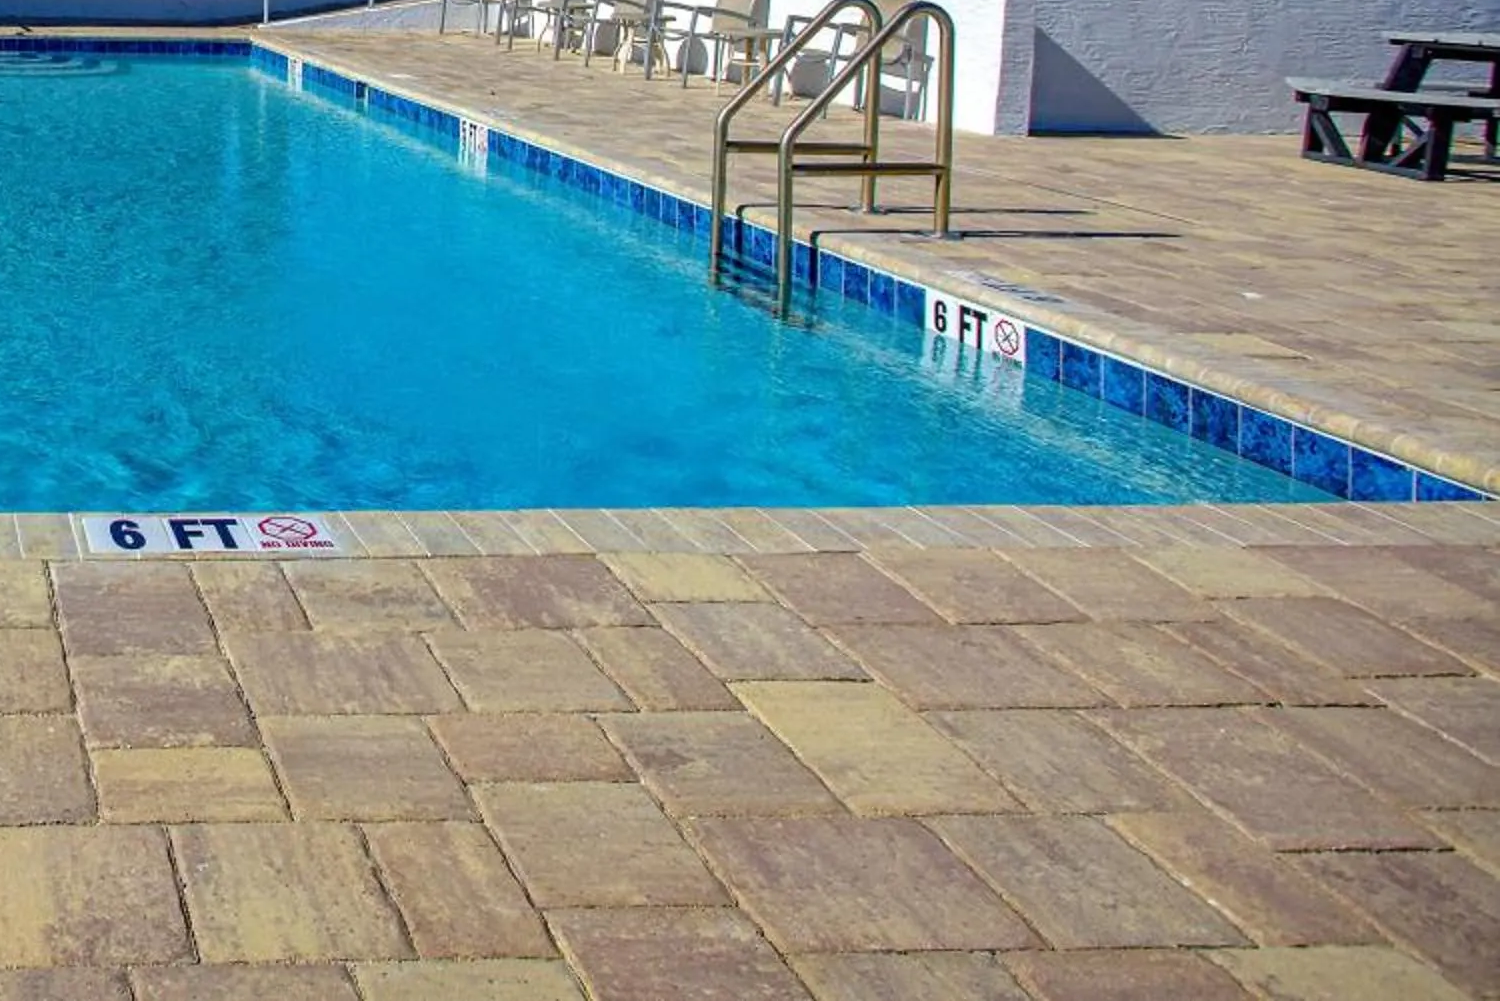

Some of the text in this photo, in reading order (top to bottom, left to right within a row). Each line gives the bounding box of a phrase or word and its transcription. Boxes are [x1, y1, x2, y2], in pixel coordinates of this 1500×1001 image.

[933, 299, 988, 351] 6 FT
[109, 518, 239, 550] 6 FT
